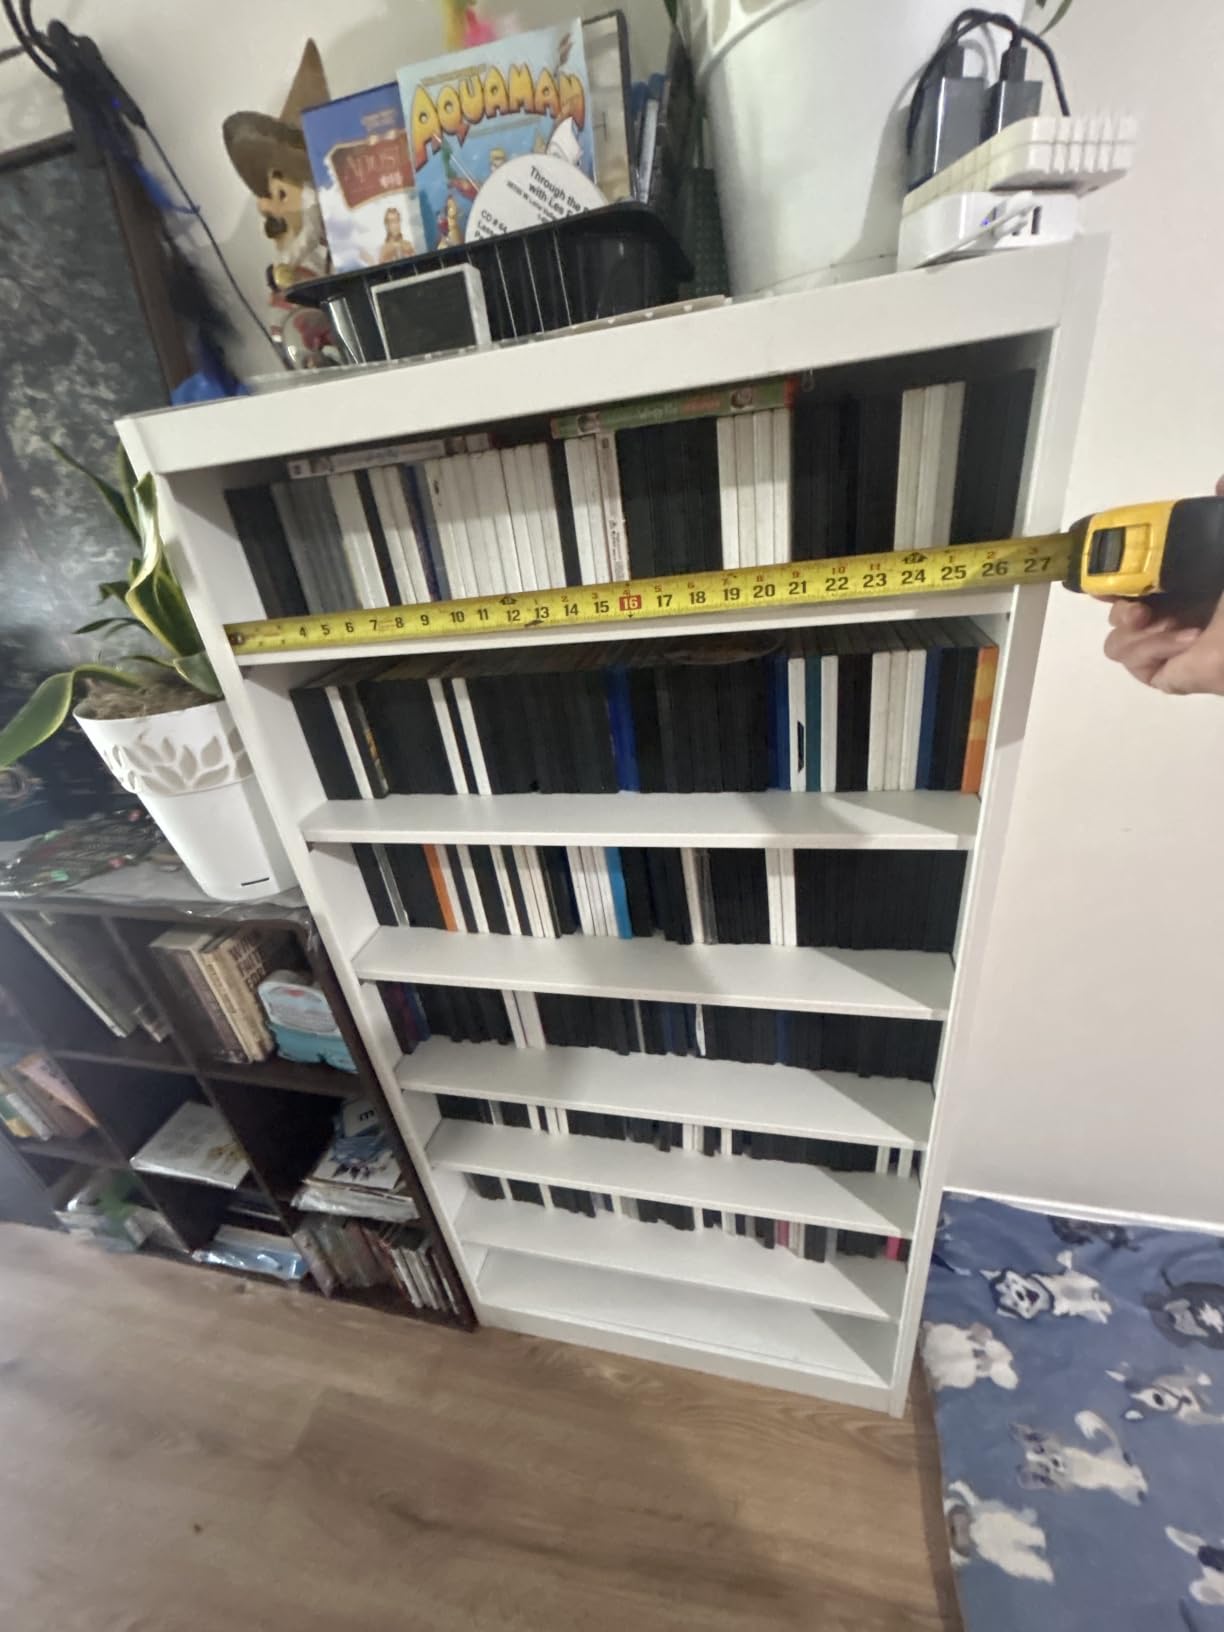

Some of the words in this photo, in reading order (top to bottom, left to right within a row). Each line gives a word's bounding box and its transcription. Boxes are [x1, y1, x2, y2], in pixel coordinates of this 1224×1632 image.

[412, 62, 585, 172] AQUAMAN
[528, 183, 547, 202] with
[530, 165, 566, 201] Through
[567, 195, 582, 213] the
[299, 625, 308, 637] 4
[322, 624, 330, 636] 5
[345, 621, 354, 633] 6
[368, 619, 378, 631] 7
[394, 616, 404, 628] 8
[420, 614, 430, 626] 9
[450, 610, 465, 623] 10
[477, 608, 489, 620] 11
[506, 609, 520, 622] 12
[534, 606, 550, 620] 13
[564, 603, 578, 616] 14
[594, 600, 610, 614] 15
[623, 596, 638, 610] 16
[656, 594, 672, 608] 17
[689, 590, 706, 604] 18
[723, 587, 740, 601] 19
[753, 584, 776, 598] 20
[788, 580, 807, 595] 21
[825, 576, 849, 592] 22
[862, 572, 887, 588] 23
[901, 569, 926, 584] 24
[941, 564, 967, 580] 25
[982, 561, 1008, 577] 26
[1024, 557, 1050, 573] 27
